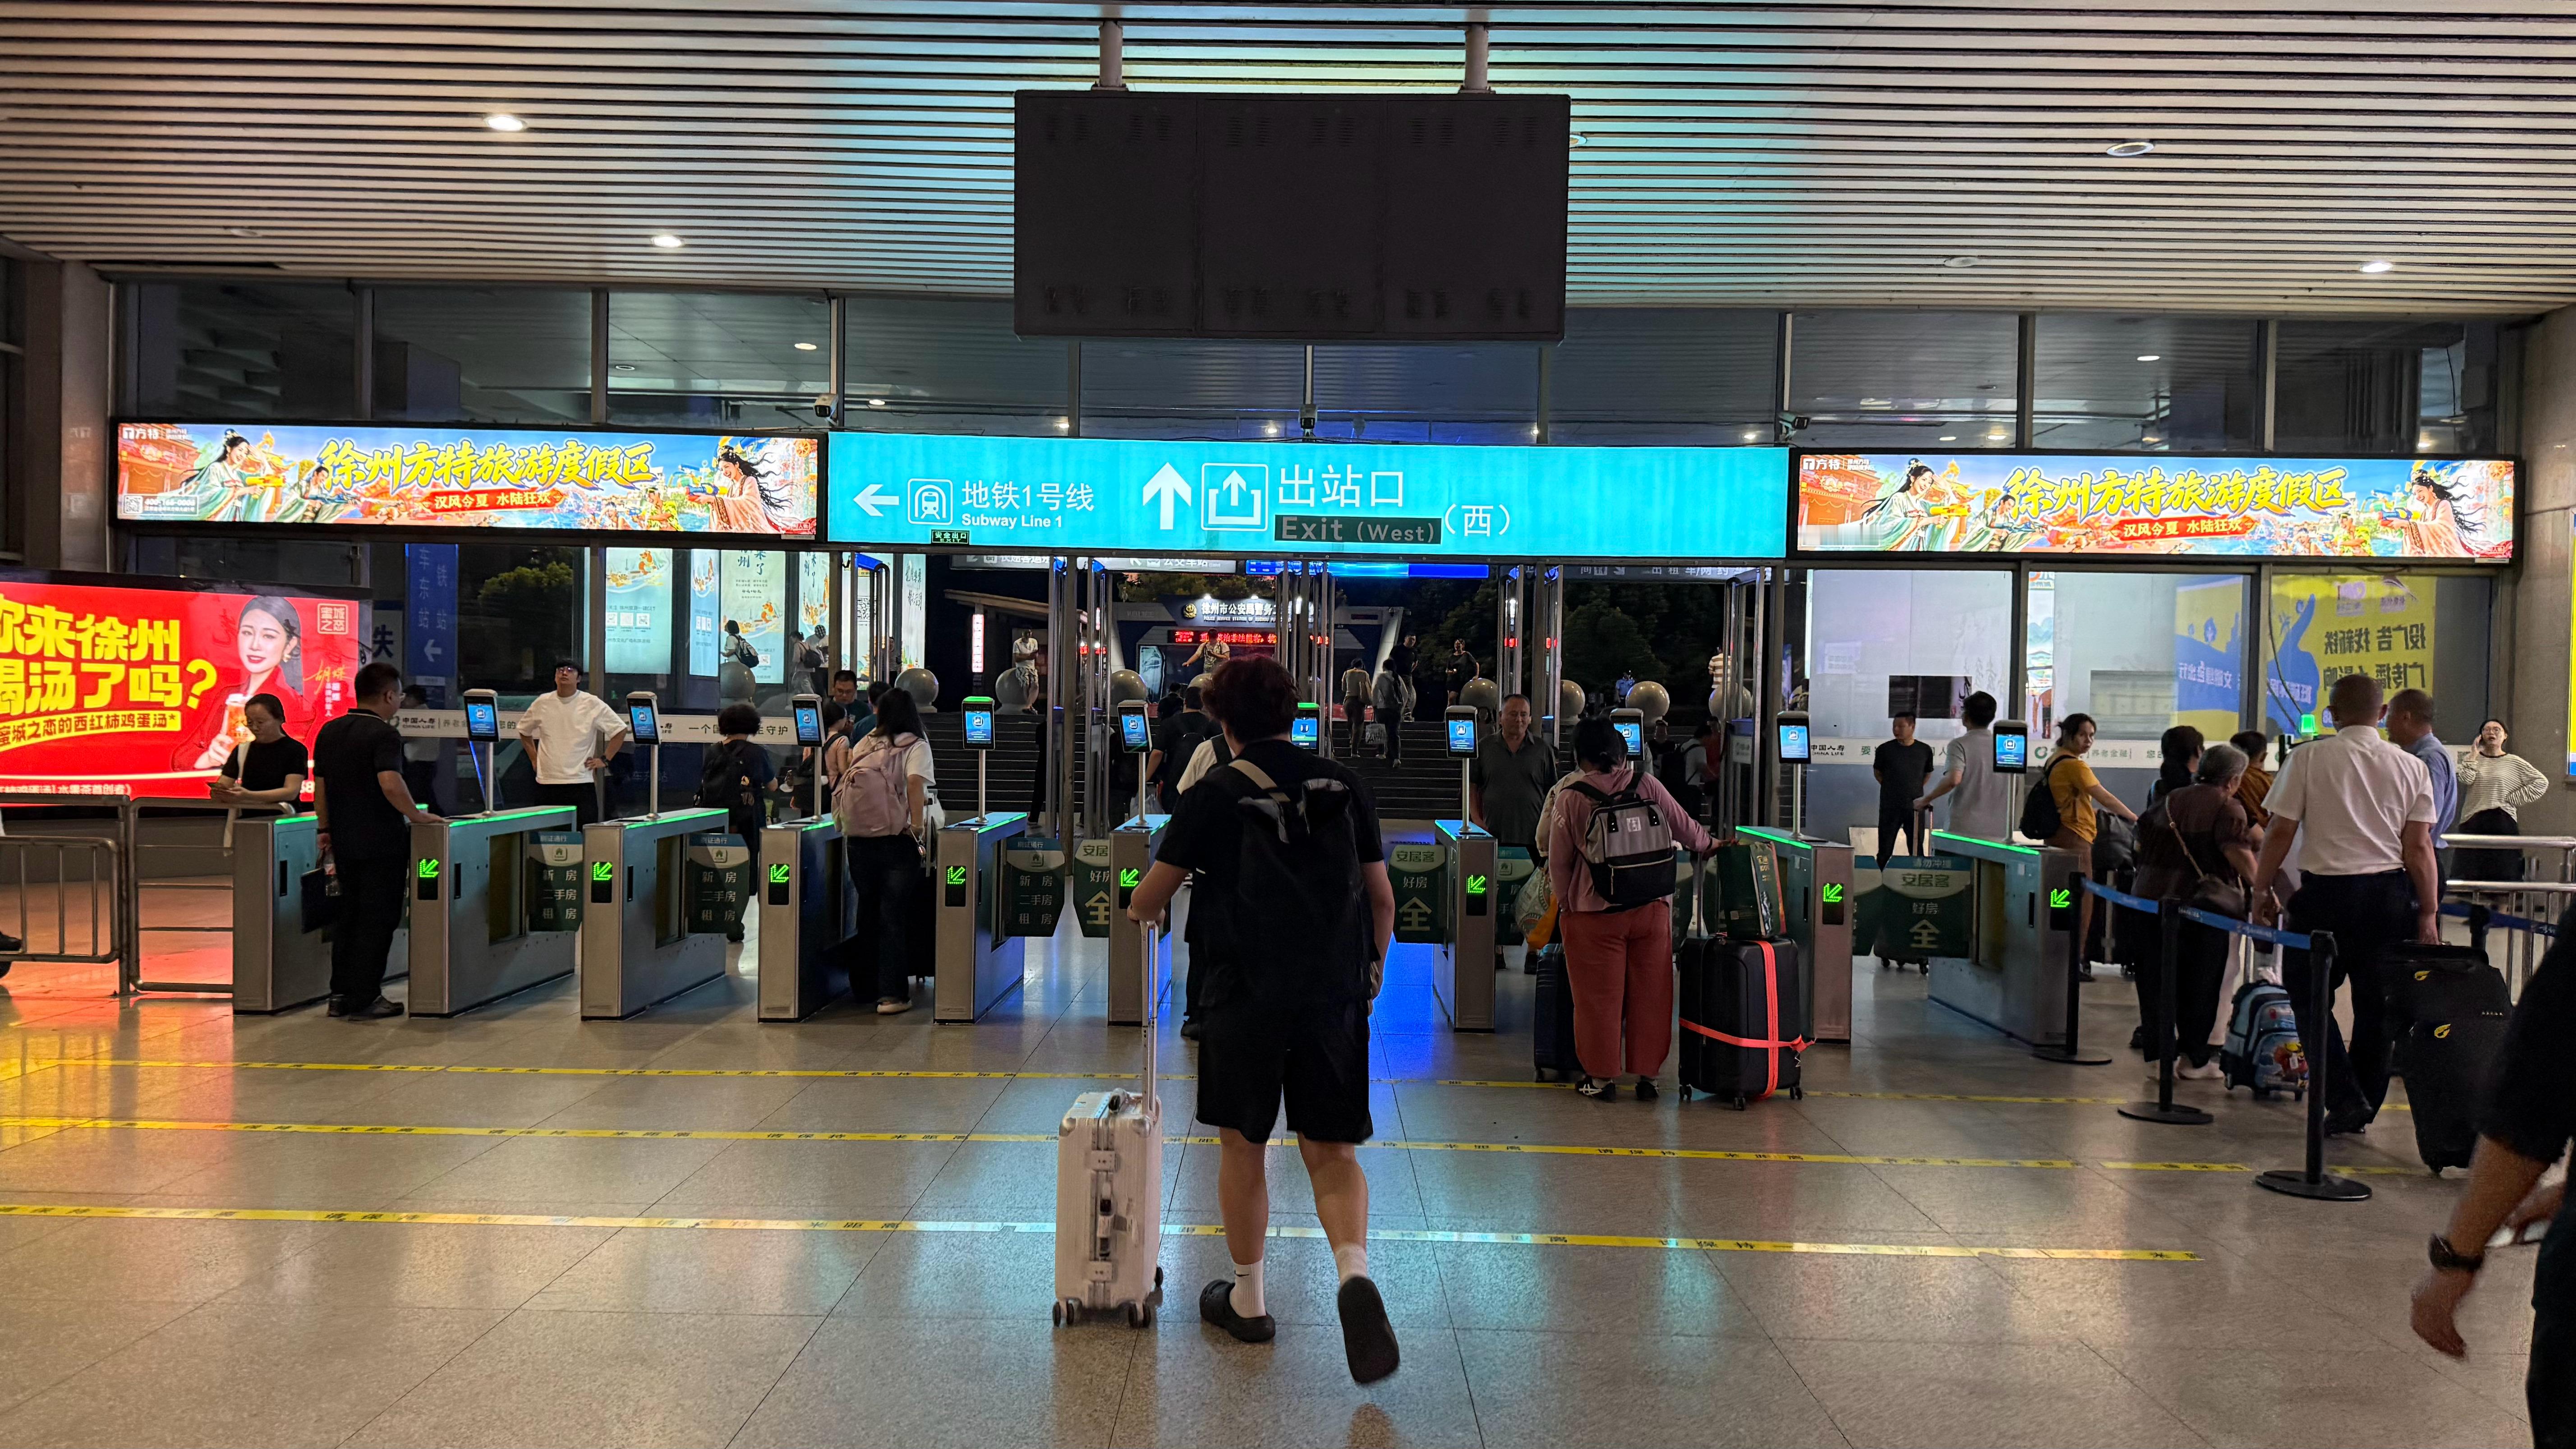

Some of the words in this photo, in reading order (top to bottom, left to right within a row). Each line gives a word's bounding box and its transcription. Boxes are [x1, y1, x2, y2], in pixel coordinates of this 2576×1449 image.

[317, 439, 657, 495] 徐州方特旅游度假区
[1816, 459, 1840, 470] 方特
[1279, 464, 1403, 508] 出站口
[497, 491, 551, 506] 水陆狂欢
[961, 480, 1094, 511] 地铁1号线
[2006, 465, 2350, 523] 徐州方特旅游度假区
[961, 513, 1017, 529] Subway
[1021, 515, 1051, 528] Line
[1054, 515, 1062, 528] 1
[2186, 519, 2242, 534] 水陆狂欢
[935, 531, 967, 539] 安全出口
[1282, 516, 1343, 541] Exit
[1357, 520, 1434, 543] (West)
[373, 625, 394, 658] 失
[1083, 845, 1109, 857] 安居
[1396, 850, 1435, 863] 安居客
[1403, 876, 1428, 889] 好房
[1901, 873, 1950, 888] 安居客
[543, 888, 577, 901] 二手房
[701, 890, 736, 902] 二手房
[1019, 894, 1052, 906] 二手房
[1085, 889, 1109, 925] 全
[1398, 896, 1432, 931] 全
[1912, 902, 1939, 915] 好房
[1909, 919, 1940, 948] 全
